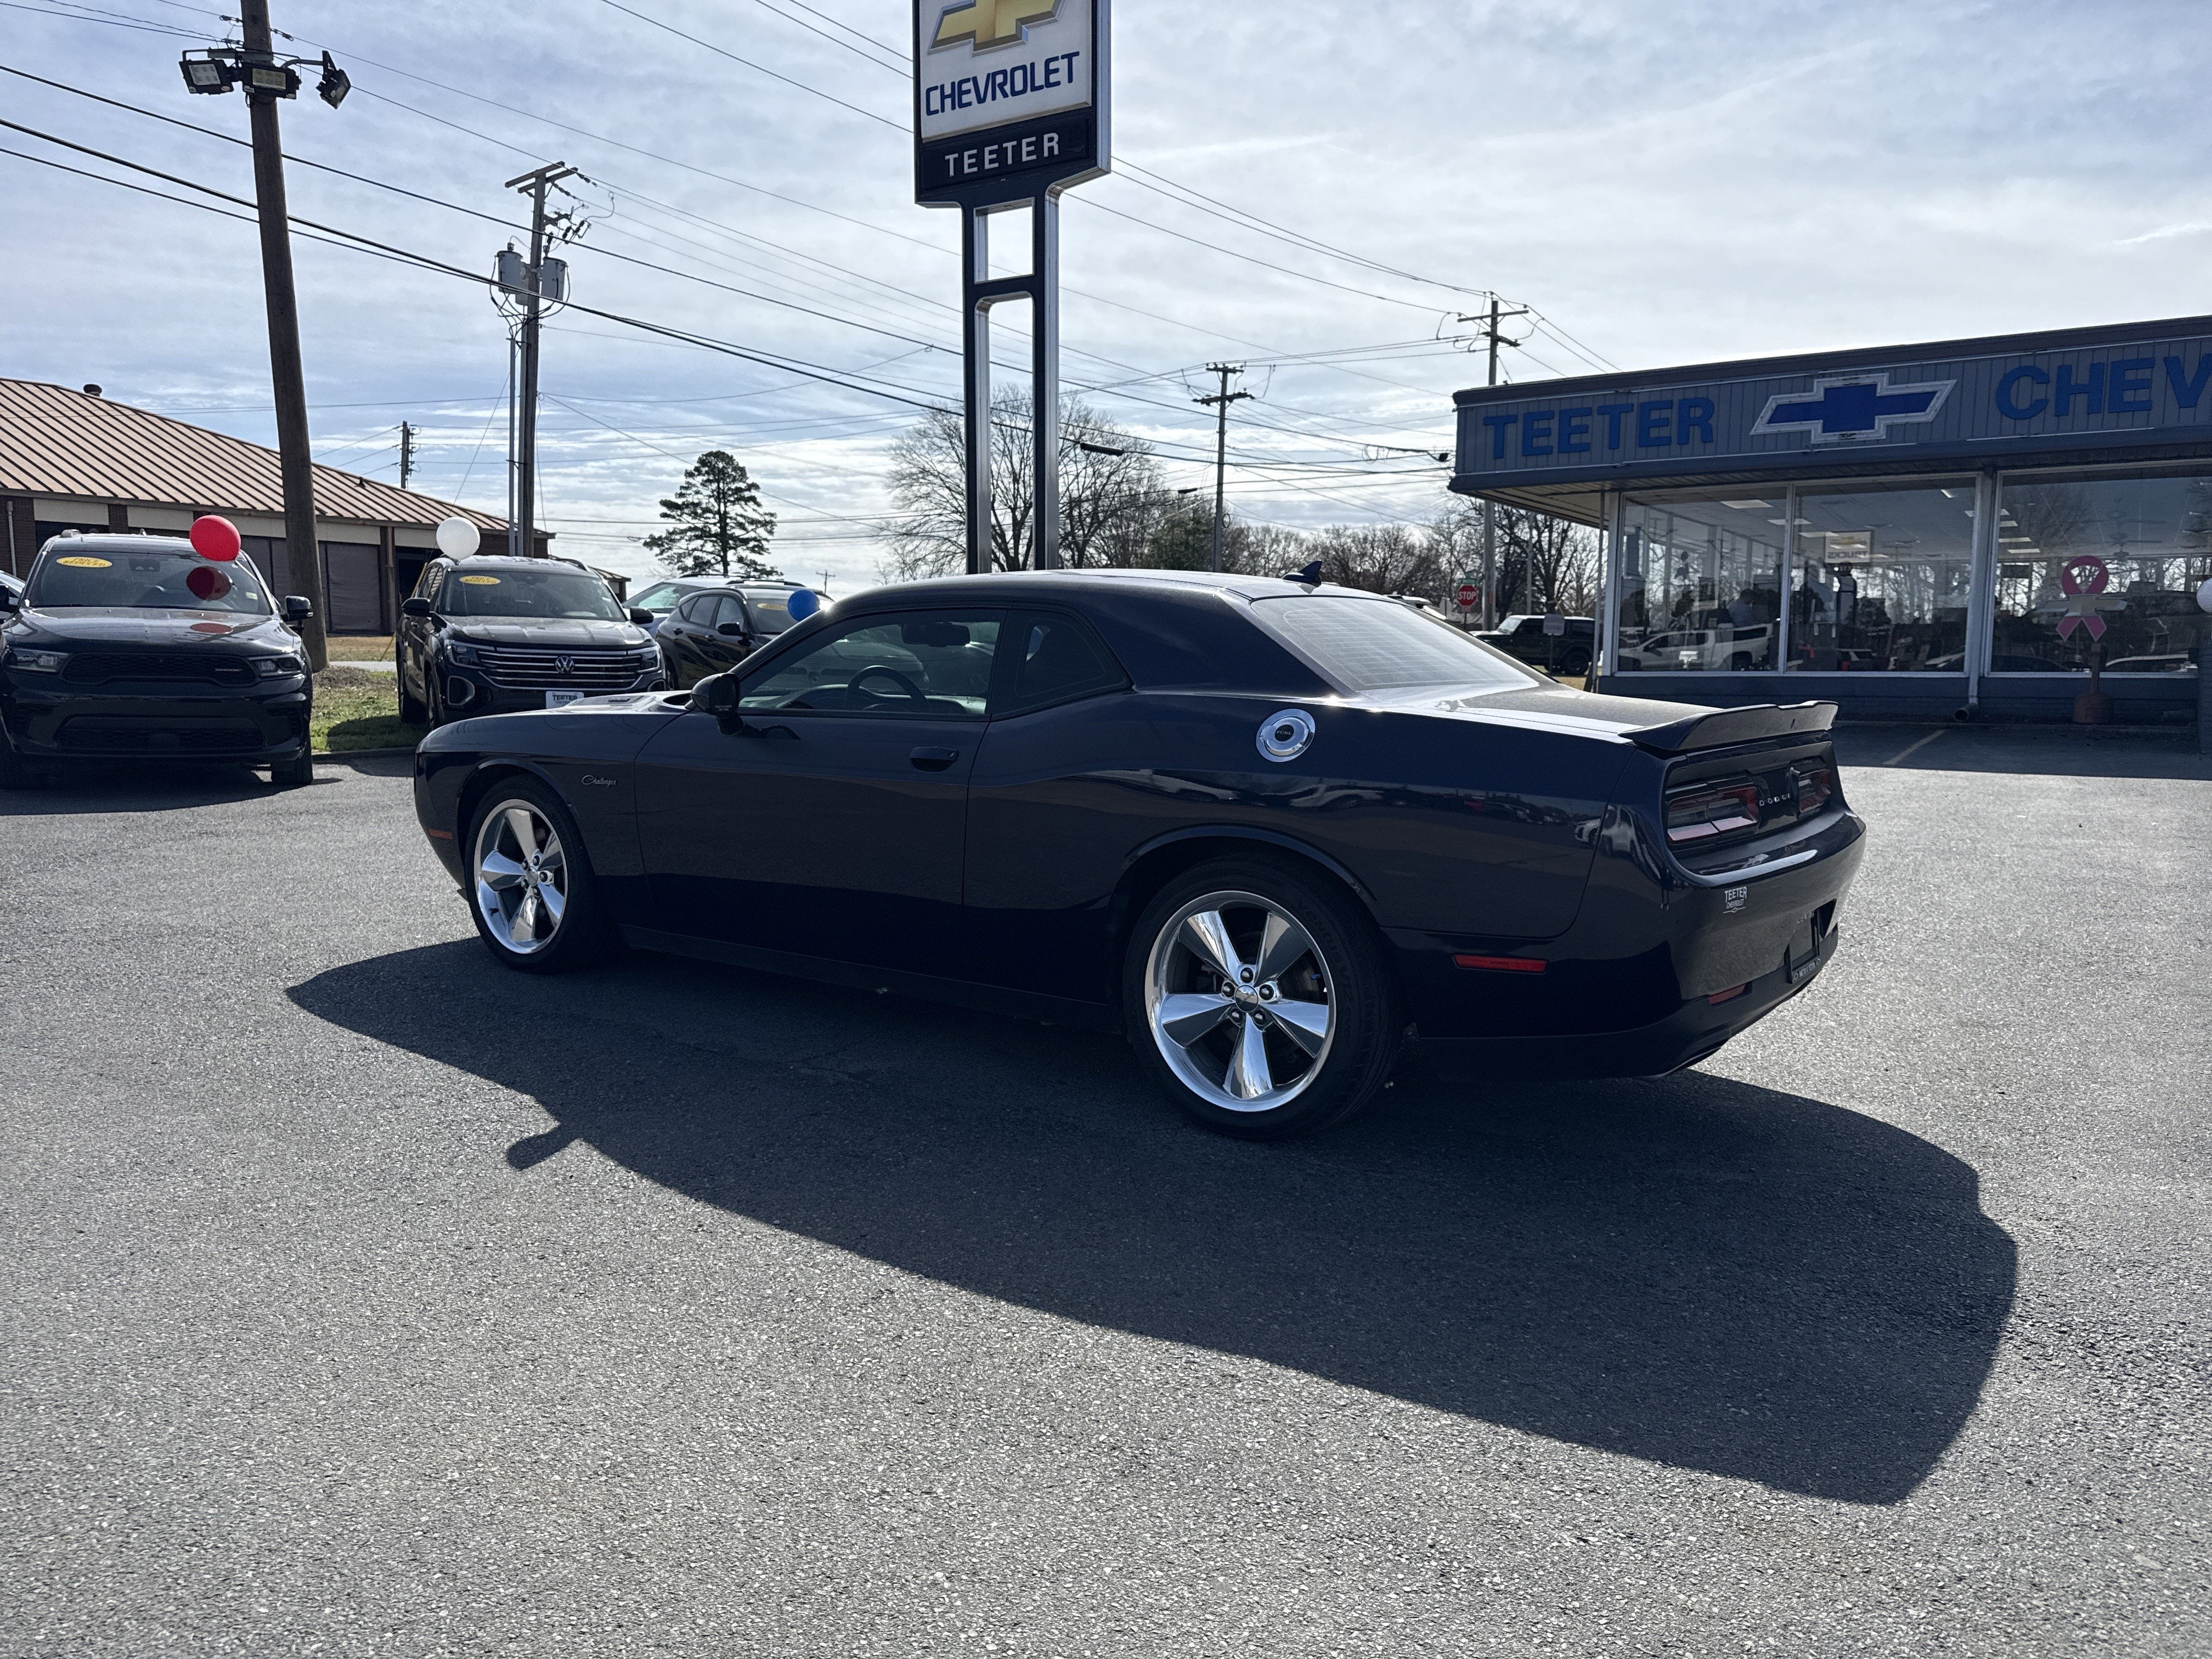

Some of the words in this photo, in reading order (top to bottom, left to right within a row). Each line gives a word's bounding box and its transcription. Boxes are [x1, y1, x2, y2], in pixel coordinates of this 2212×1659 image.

[926, 52, 1080, 116] CHEVROLET
[945, 133, 1059, 177] TEETER
[1483, 397, 1716, 459] TEETER
[1996, 353, 2212, 420] CHEV
[1458, 591, 1476, 600] STOP
[582, 774, 617, 788] Challenger
[1724, 886, 1747, 903] TEETER
